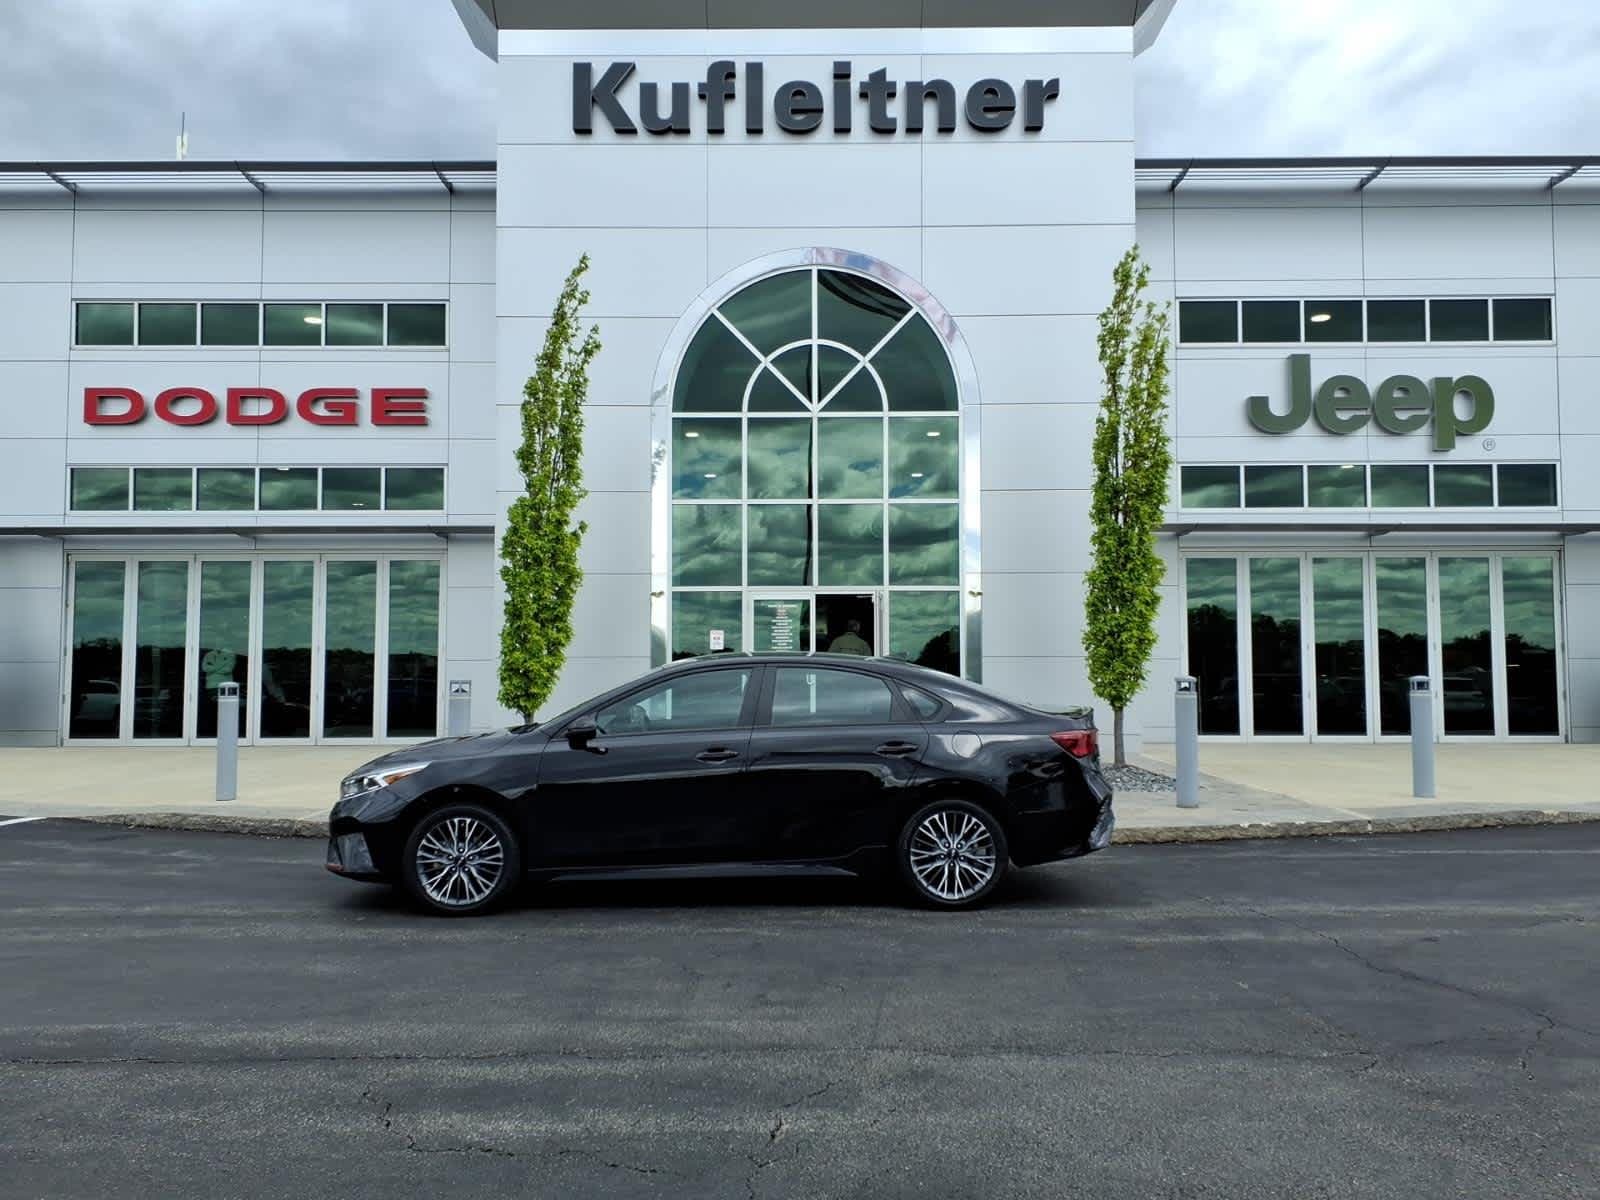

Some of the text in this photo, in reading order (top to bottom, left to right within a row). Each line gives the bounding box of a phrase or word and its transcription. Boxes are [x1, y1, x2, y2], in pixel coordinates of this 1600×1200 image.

[573, 60, 1060, 134] Kufleitner
[84, 387, 429, 426] DODGE
[1247, 353, 1495, 452] Jeep
